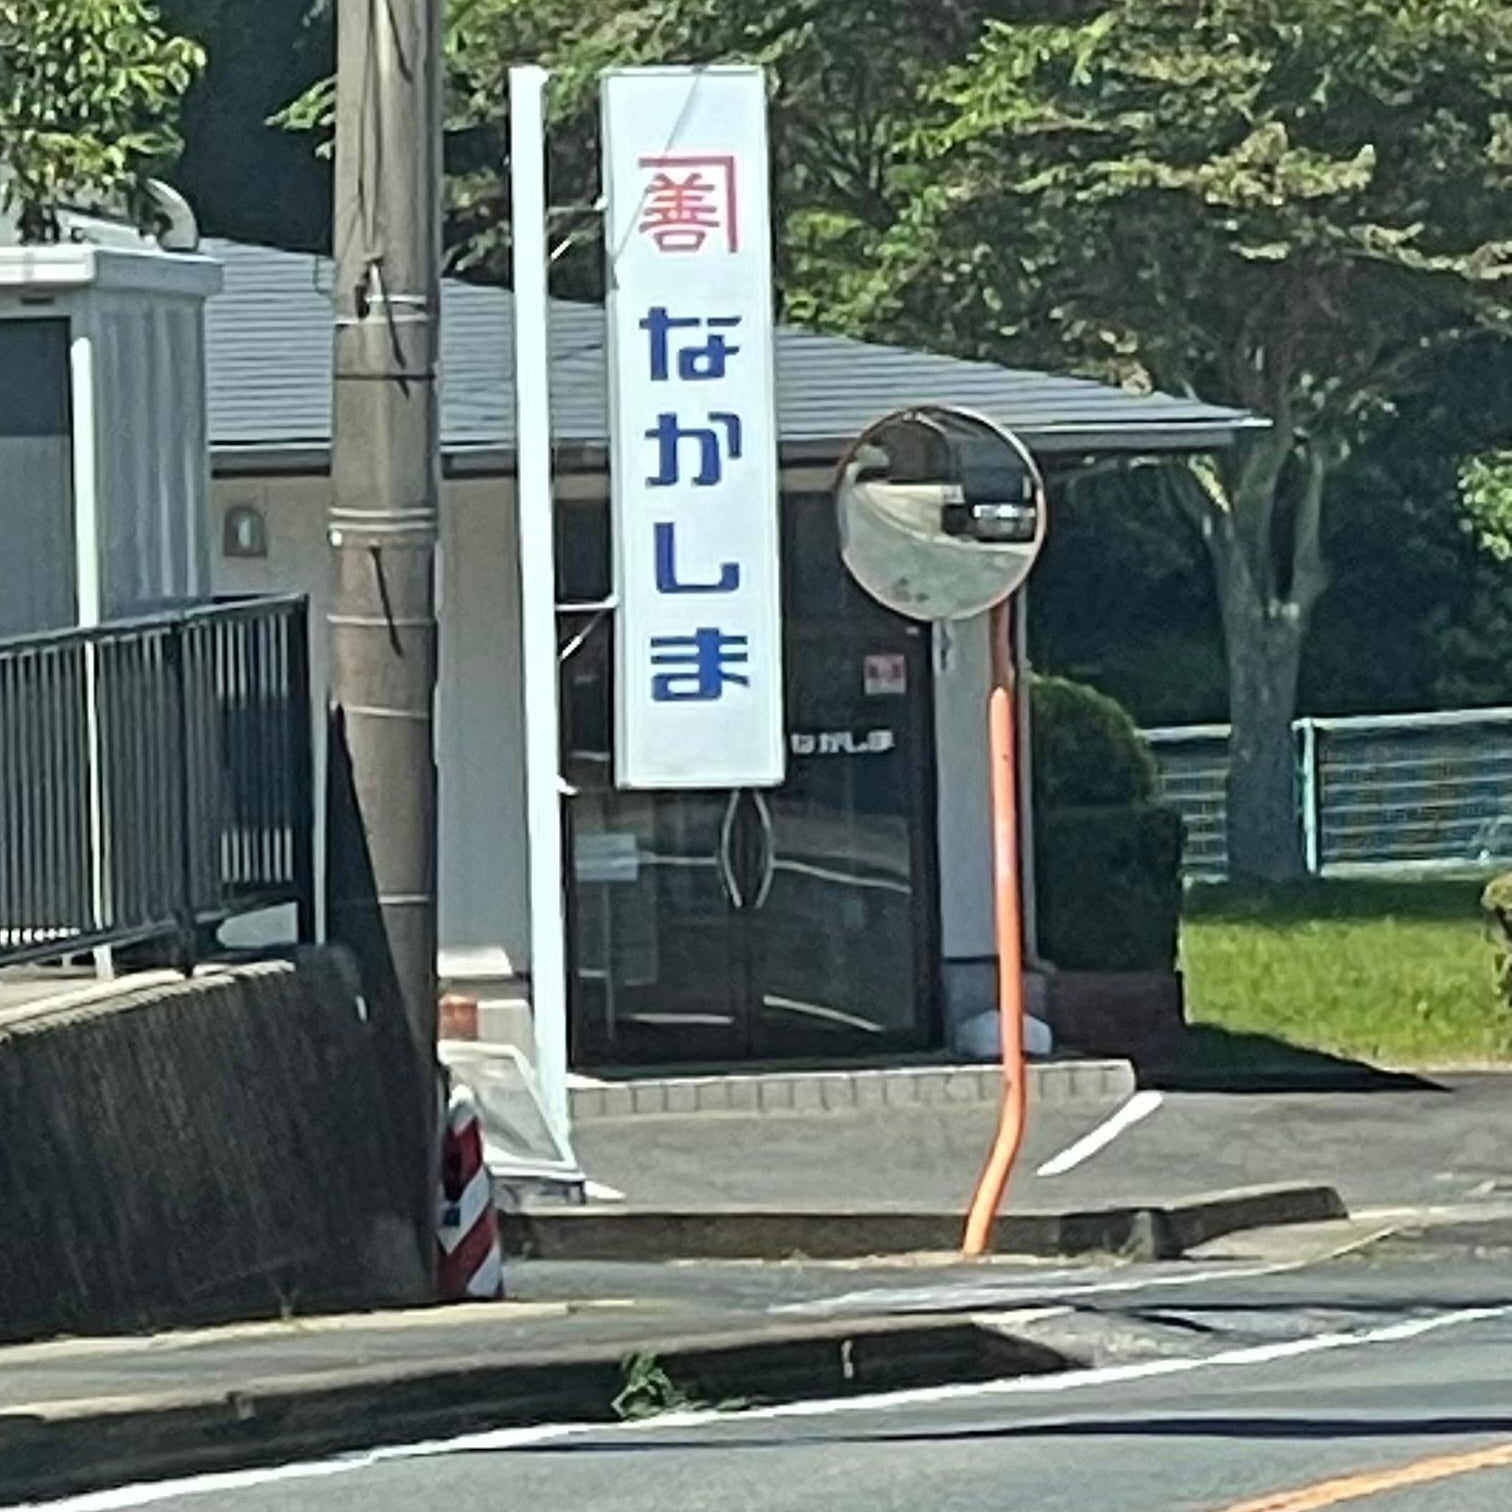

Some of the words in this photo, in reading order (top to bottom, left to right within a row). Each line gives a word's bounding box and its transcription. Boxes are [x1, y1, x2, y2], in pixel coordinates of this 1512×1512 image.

[638, 172, 720, 253] 善
[638, 305, 749, 702] なかしま
